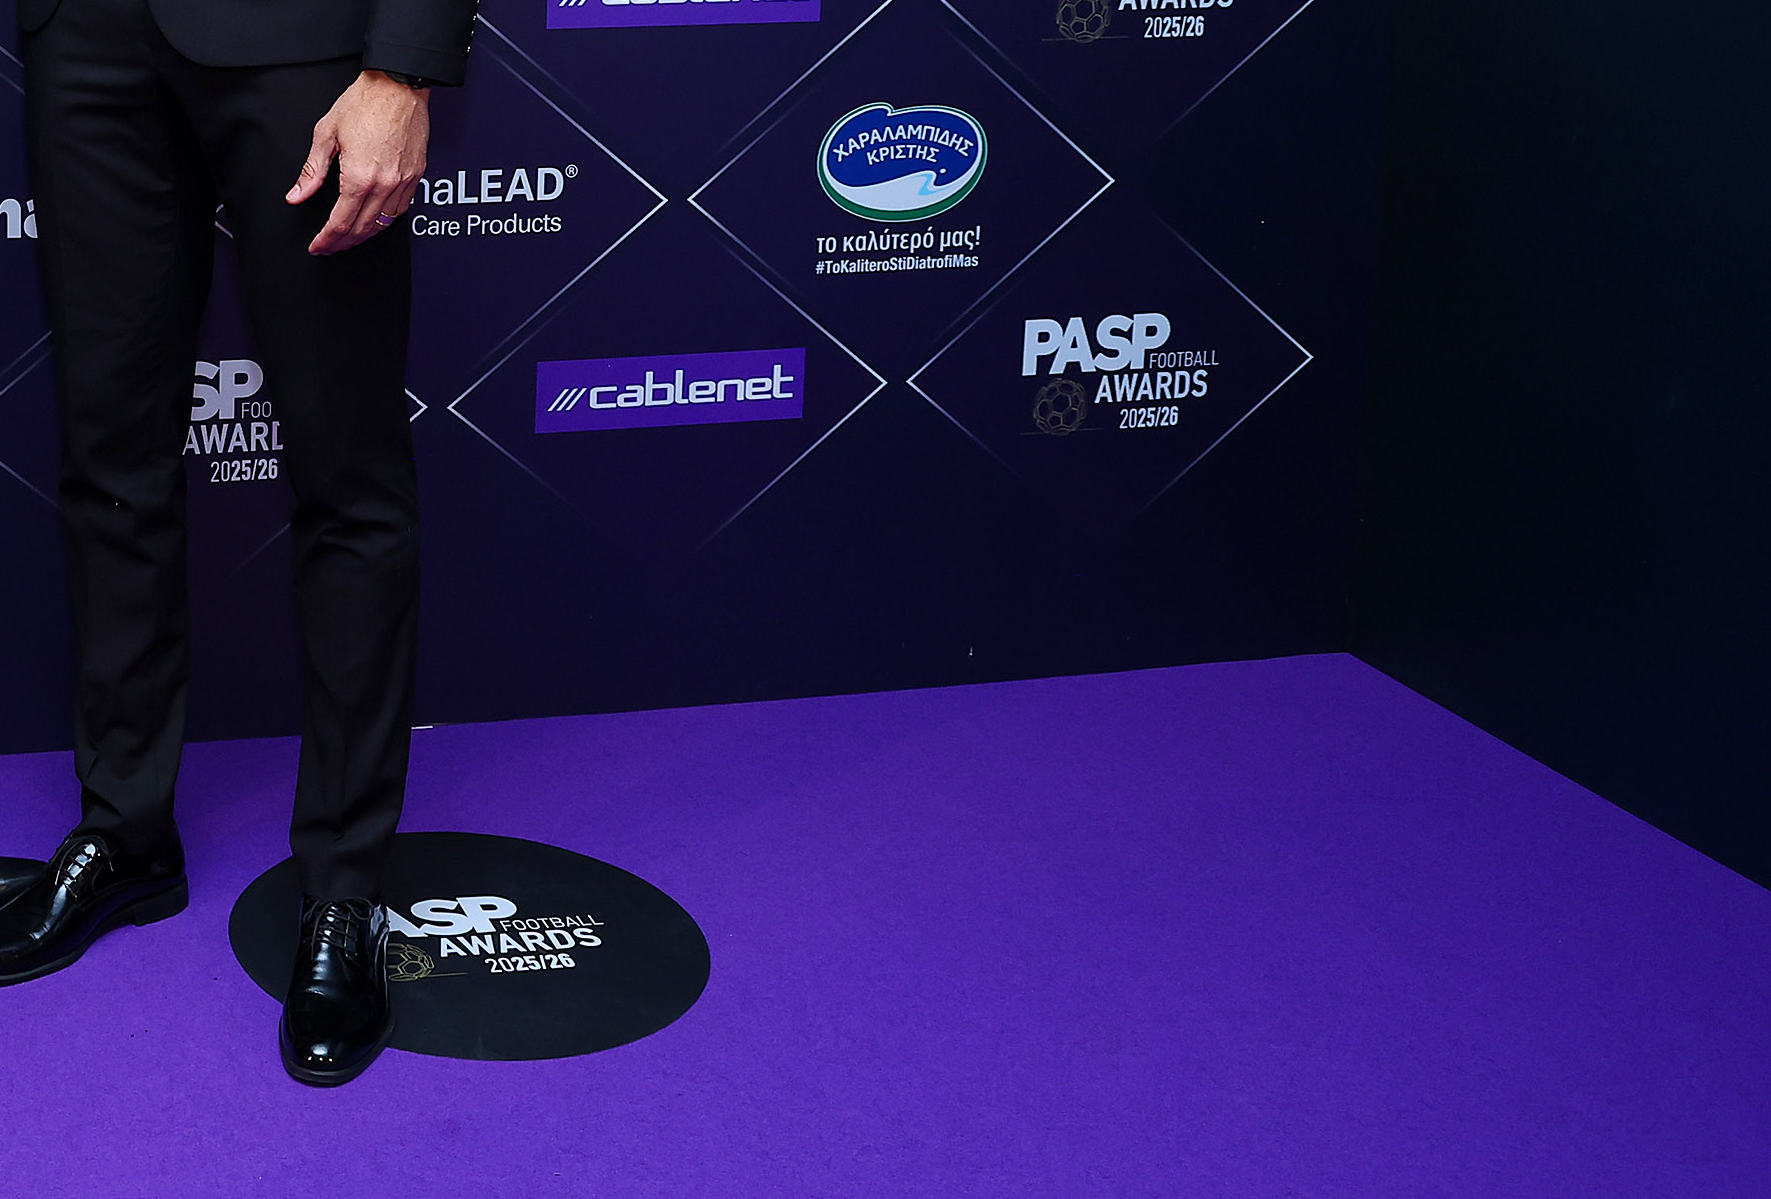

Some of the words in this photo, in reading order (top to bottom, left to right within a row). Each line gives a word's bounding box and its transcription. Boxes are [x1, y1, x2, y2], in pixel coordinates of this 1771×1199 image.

[1143, 15, 1205, 39] 2025/26
[832, 125, 974, 162] ΧΑΡΑΛΑΜΠΙΔΗΣ
[867, 144, 940, 165] ΚΡΙΣΤΗΣ
[411, 214, 461, 237] Care
[467, 212, 562, 236] Products
[816, 236, 837, 254] το
[842, 226, 934, 254] καλύτερό
[939, 225, 981, 252] μας!
[815, 253, 979, 275] #ToKaliteroStiDiatrofiMas
[1021, 312, 1171, 377] PASP
[1149, 349, 1220, 369] FOOTBALL
[190, 359, 264, 422] SP
[589, 364, 794, 409] cablenet
[1094, 369, 1209, 404] AWARDS
[1119, 405, 1179, 429] 2025/26
[181, 420, 284, 456] AWAR
[210, 458, 278, 483] 2025/26
[499, 914, 605, 932] FOOTBALL
[440, 927, 602, 958] AWARDS
[484, 952, 576, 973] 2025/26
